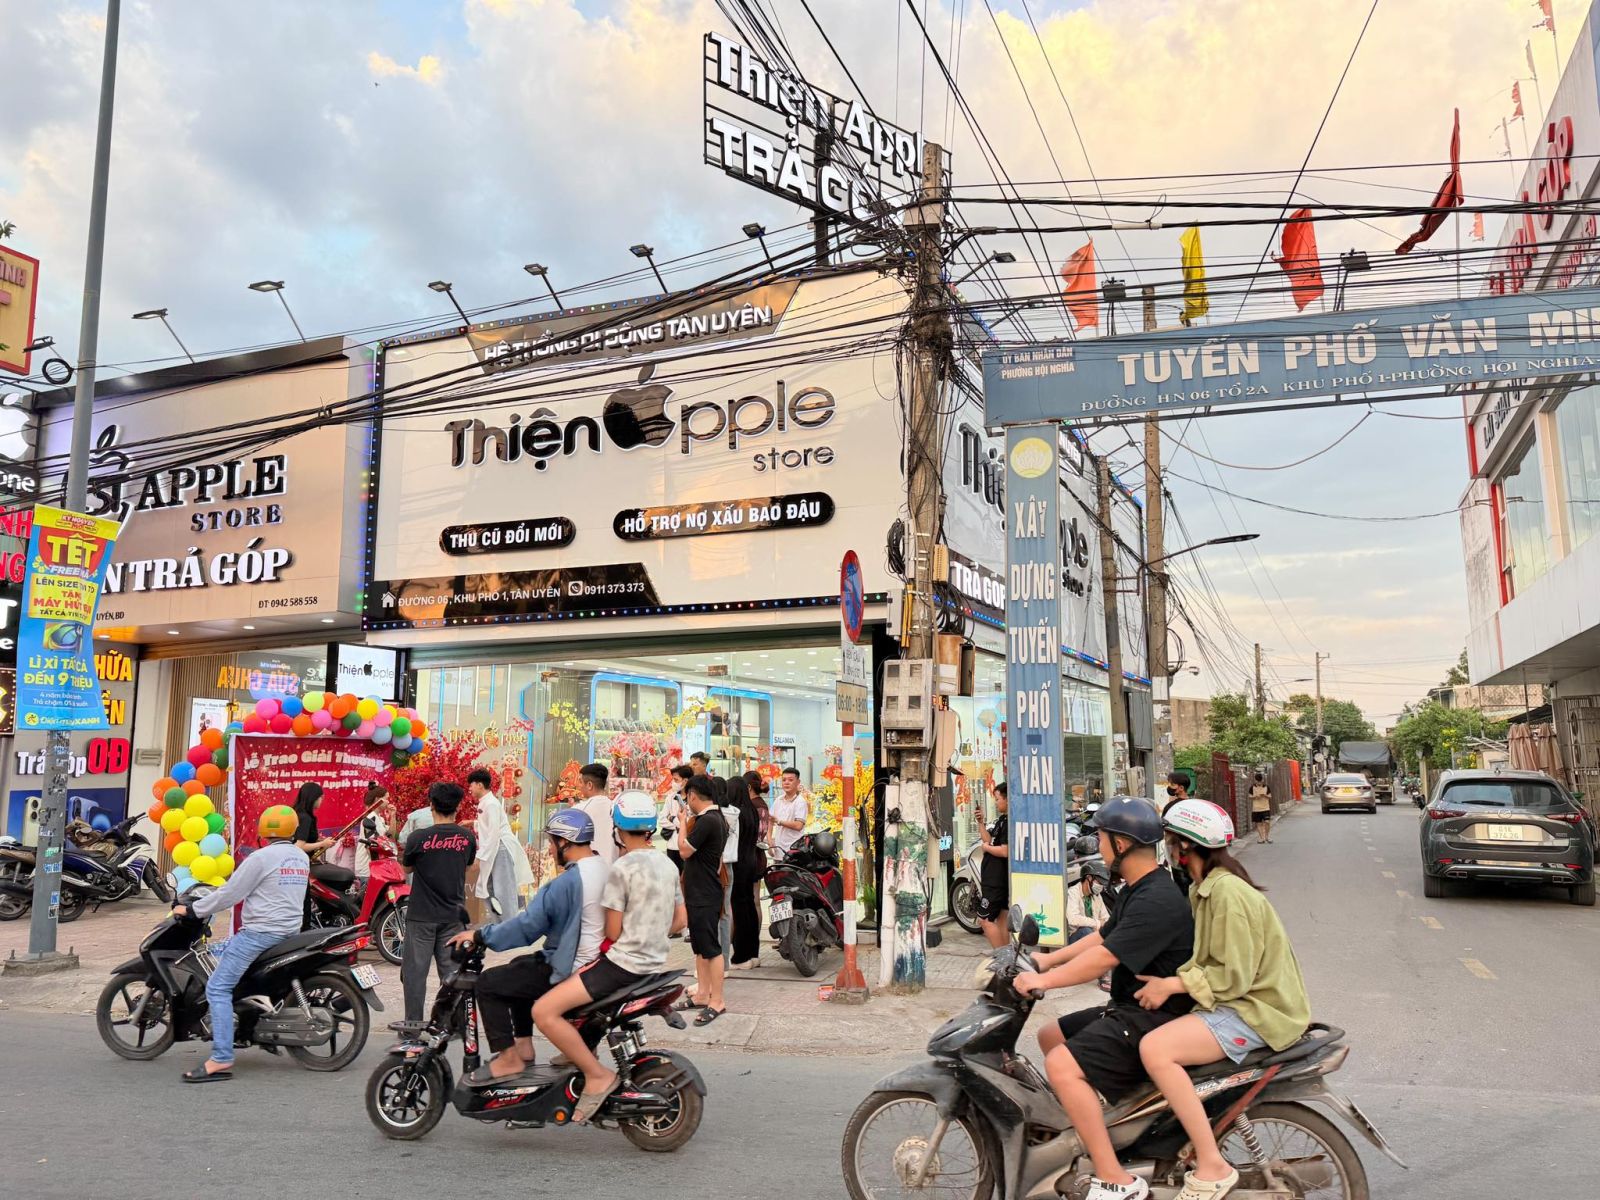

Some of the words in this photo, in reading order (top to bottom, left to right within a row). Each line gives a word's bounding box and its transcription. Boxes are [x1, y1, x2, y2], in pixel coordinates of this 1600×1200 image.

[842, 100, 924, 177] Appl
[710, 117, 811, 200] TRẢ
[667, 313, 708, 338] TÂN
[711, 302, 773, 331] UYÊN
[1014, 351, 1031, 363] BAN
[1032, 347, 1055, 361] NHÂN
[1056, 346, 1073, 359] DÂN
[1118, 333, 1260, 386] TUYẾN
[1283, 318, 1380, 370] PHỐ
[1400, 313, 1498, 359] VĂN
[1528, 306, 1600, 347] MI
[1001, 365, 1034, 380] PHƯỜNG
[1034, 363, 1049, 378] HỘI
[1190, 390, 1210, 400] 06
[1246, 384, 1269, 396] 2A
[1283, 378, 1325, 392] KHU
[1332, 369, 1374, 388] PHỐ
[1483, 359, 1518, 377] HỘI
[444, 407, 602, 472] Thiện
[752, 445, 836, 472] store
[134, 454, 287, 511] APPLE
[190, 503, 283, 533] STORE
[624, 511, 645, 533] HỖ
[650, 513, 681, 533] TRỢ
[685, 510, 708, 532] NỢ
[712, 504, 743, 526] XẤU
[786, 500, 821, 522] ĐẬU
[1014, 495, 1048, 539] XÂY
[46, 532, 99, 569] TẾT
[450, 532, 477, 549] THU
[481, 528, 501, 546] CŨ
[505, 522, 530, 544] ĐỔI
[534, 523, 562, 542] MỚI
[129, 547, 207, 592] TRẢ
[210, 536, 291, 584] GÓP
[951, 561, 982, 601] TRẢ
[35, 576, 55, 586] LÊN
[57, 580, 79, 589] SIZE
[454, 592, 476, 604] KHU
[510, 587, 531, 600] TÂN
[532, 585, 561, 598] UYÊN
[584, 584, 606, 595] 0911
[607, 583, 625, 594] 373
[626, 582, 645, 593] 373
[1011, 560, 1055, 608] DỰNG
[270, 598, 289, 608] 0942
[1009, 616, 1057, 665] TUYẾN
[23, 669, 55, 686] ĐẾN
[58, 672, 69, 686] 9
[94, 649, 133, 681] HỮA
[1016, 680, 1052, 729] PHỐ
[67, 751, 87, 777] óp
[263, 753, 298, 768] Trao
[1019, 747, 1054, 795] VĂN
